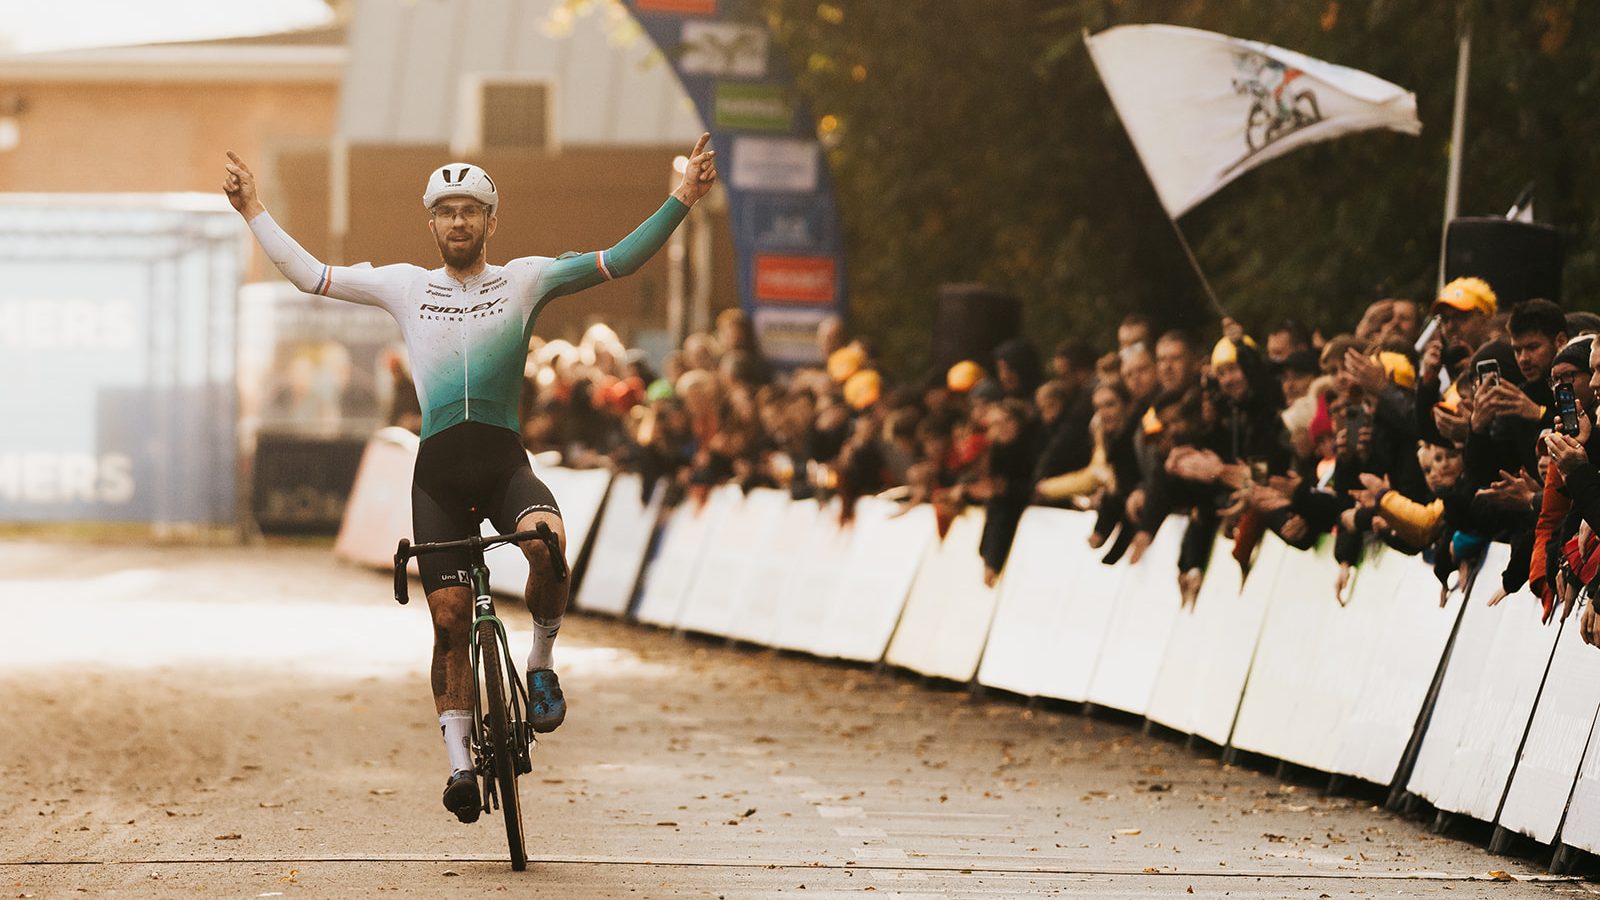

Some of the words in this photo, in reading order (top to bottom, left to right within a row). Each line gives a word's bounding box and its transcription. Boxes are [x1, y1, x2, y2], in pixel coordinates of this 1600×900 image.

[420, 298, 502, 314] RIDLEY
[420, 314, 463, 322] RACING
[473, 308, 504, 319] TEAM
